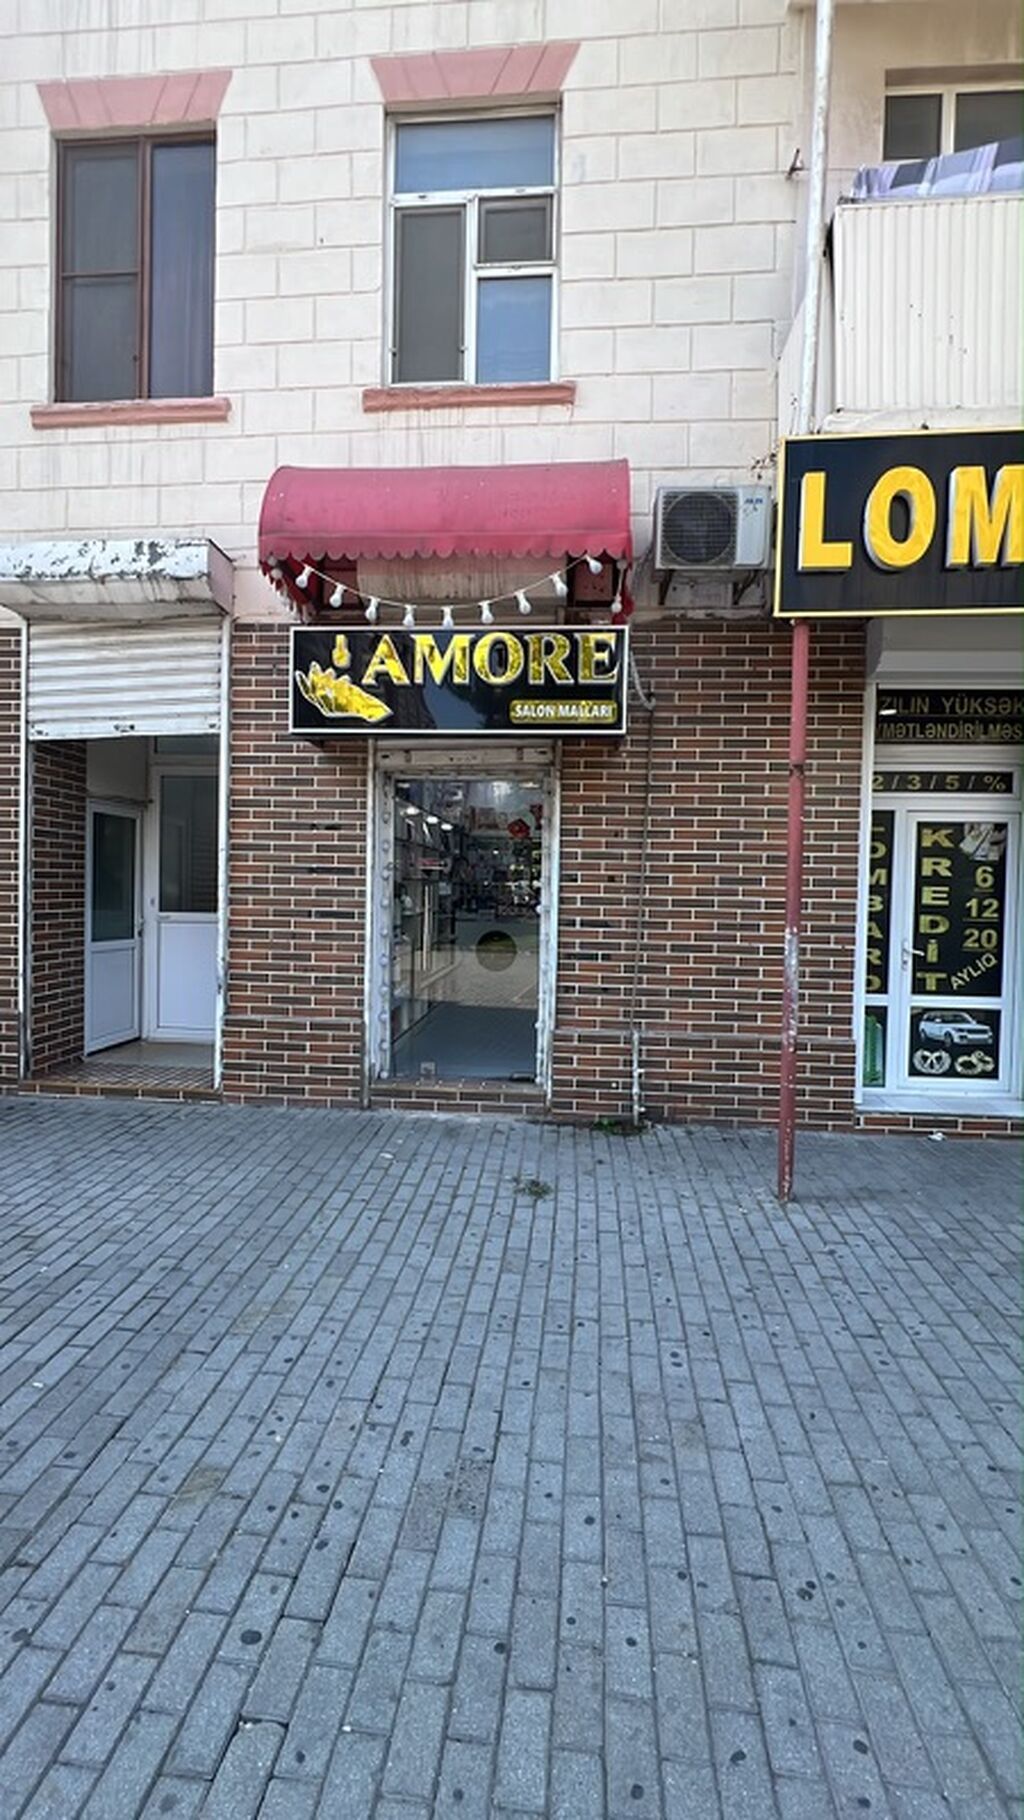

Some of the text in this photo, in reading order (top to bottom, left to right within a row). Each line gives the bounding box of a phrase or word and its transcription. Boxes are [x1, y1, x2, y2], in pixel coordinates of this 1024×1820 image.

[798, 464, 1024, 572] LOM
[361, 632, 621, 686] AMORE
[515, 704, 555, 718] SALON
[975, 866, 994, 888] 6
[965, 898, 999, 918] 12
[963, 928, 998, 949] 20
[950, 952, 998, 990] AYLIQ
